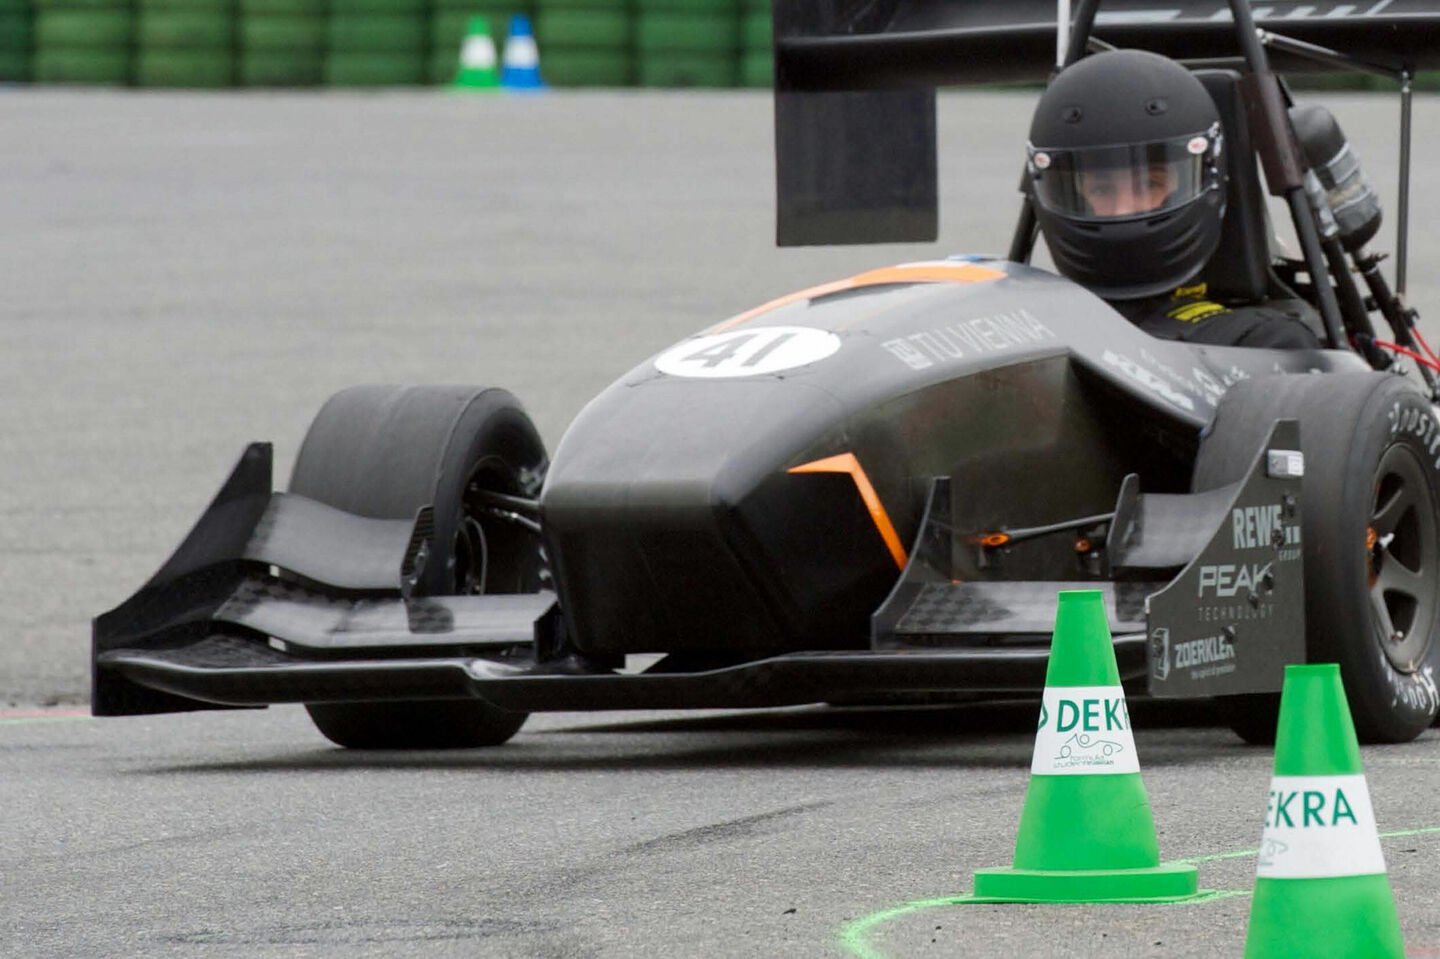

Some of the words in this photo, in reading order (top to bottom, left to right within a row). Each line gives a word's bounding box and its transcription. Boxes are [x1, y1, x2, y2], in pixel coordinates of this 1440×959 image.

[680, 333, 799, 368] 41
[908, 329, 963, 361] TU
[945, 309, 1056, 353] VIENNA
[1233, 504, 1283, 549] REWE
[1198, 562, 1273, 598] PEAK
